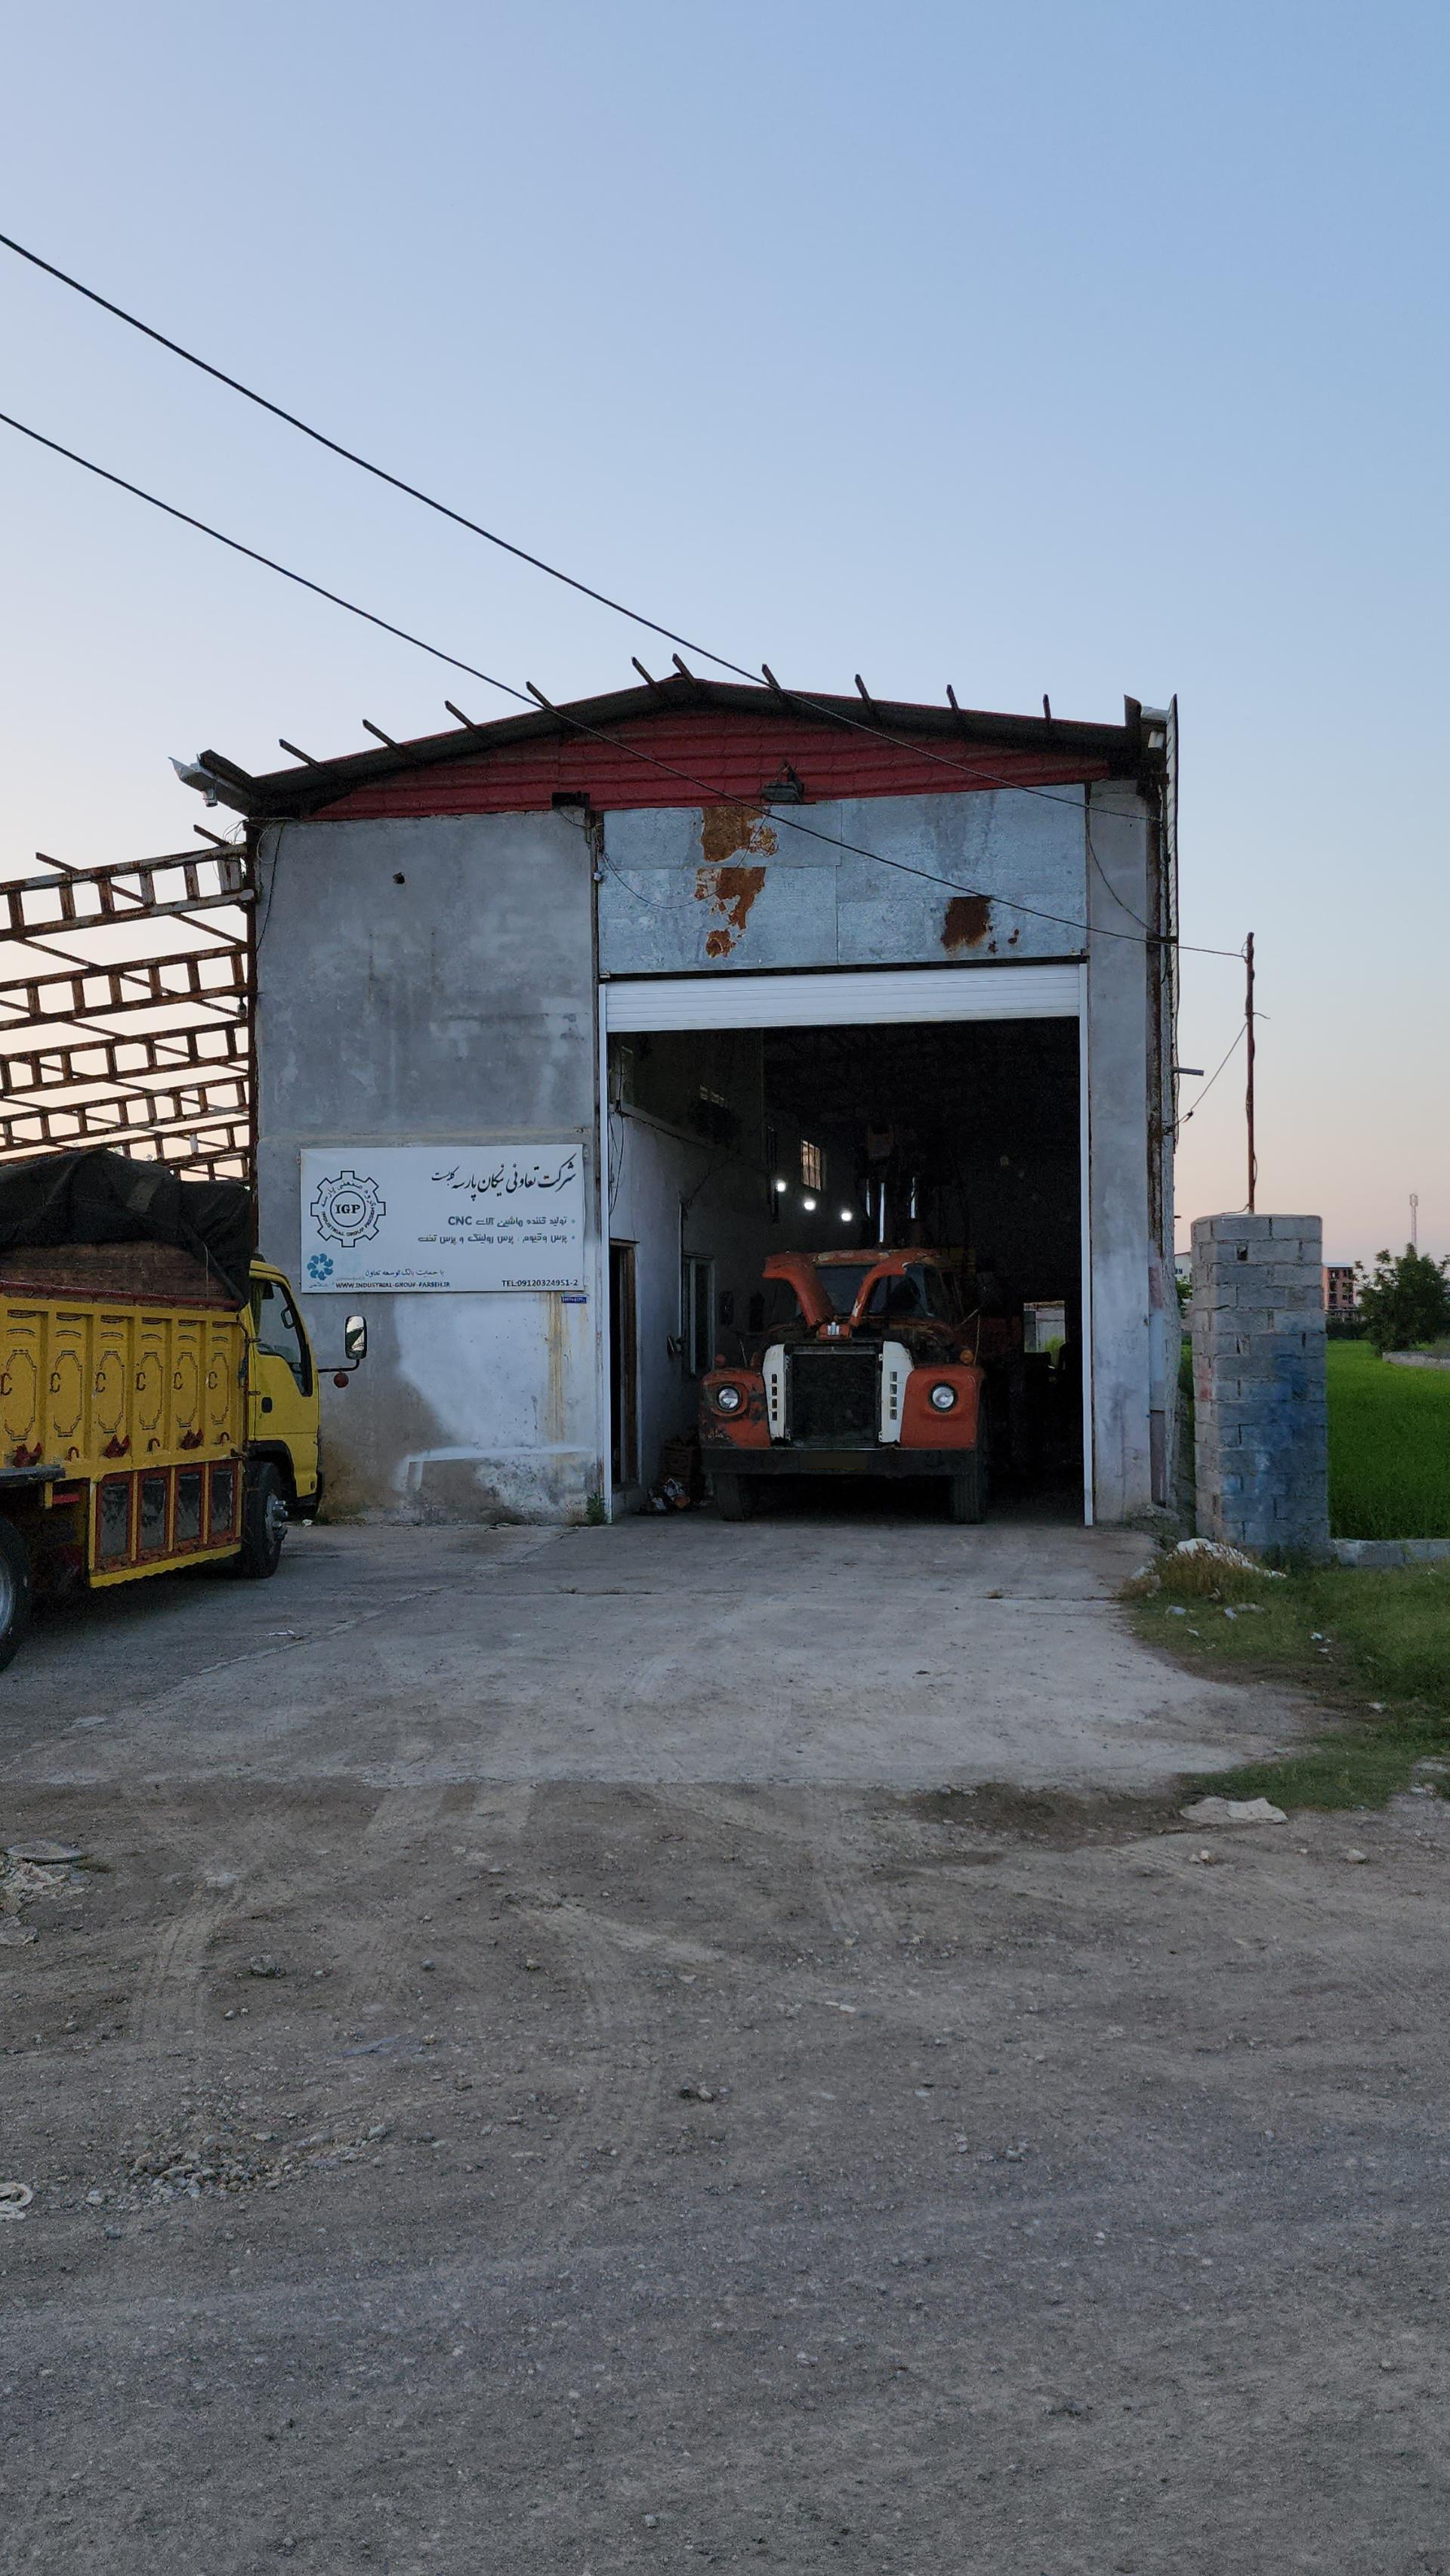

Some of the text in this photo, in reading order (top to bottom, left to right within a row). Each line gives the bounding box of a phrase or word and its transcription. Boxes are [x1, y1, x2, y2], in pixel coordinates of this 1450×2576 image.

[538, 1153, 577, 1192] شرکت
[477, 1164, 505, 1197] نیکان
[506, 1164, 540, 1193] تعاونی
[452, 1173, 477, 1201] پارسه
[335, 1204, 361, 1214] IGP
[448, 1215, 472, 1226] CNC
[497, 1215, 523, 1228] ماشین
[526, 1216, 548, 1225] کننده
[550, 1215, 568, 1227] تولید
[439, 1235, 457, 1246] پرس
[459, 1236, 464, 1244] و
[497, 1235, 514, 1245] پرس
[550, 1234, 568, 1245] پرس
